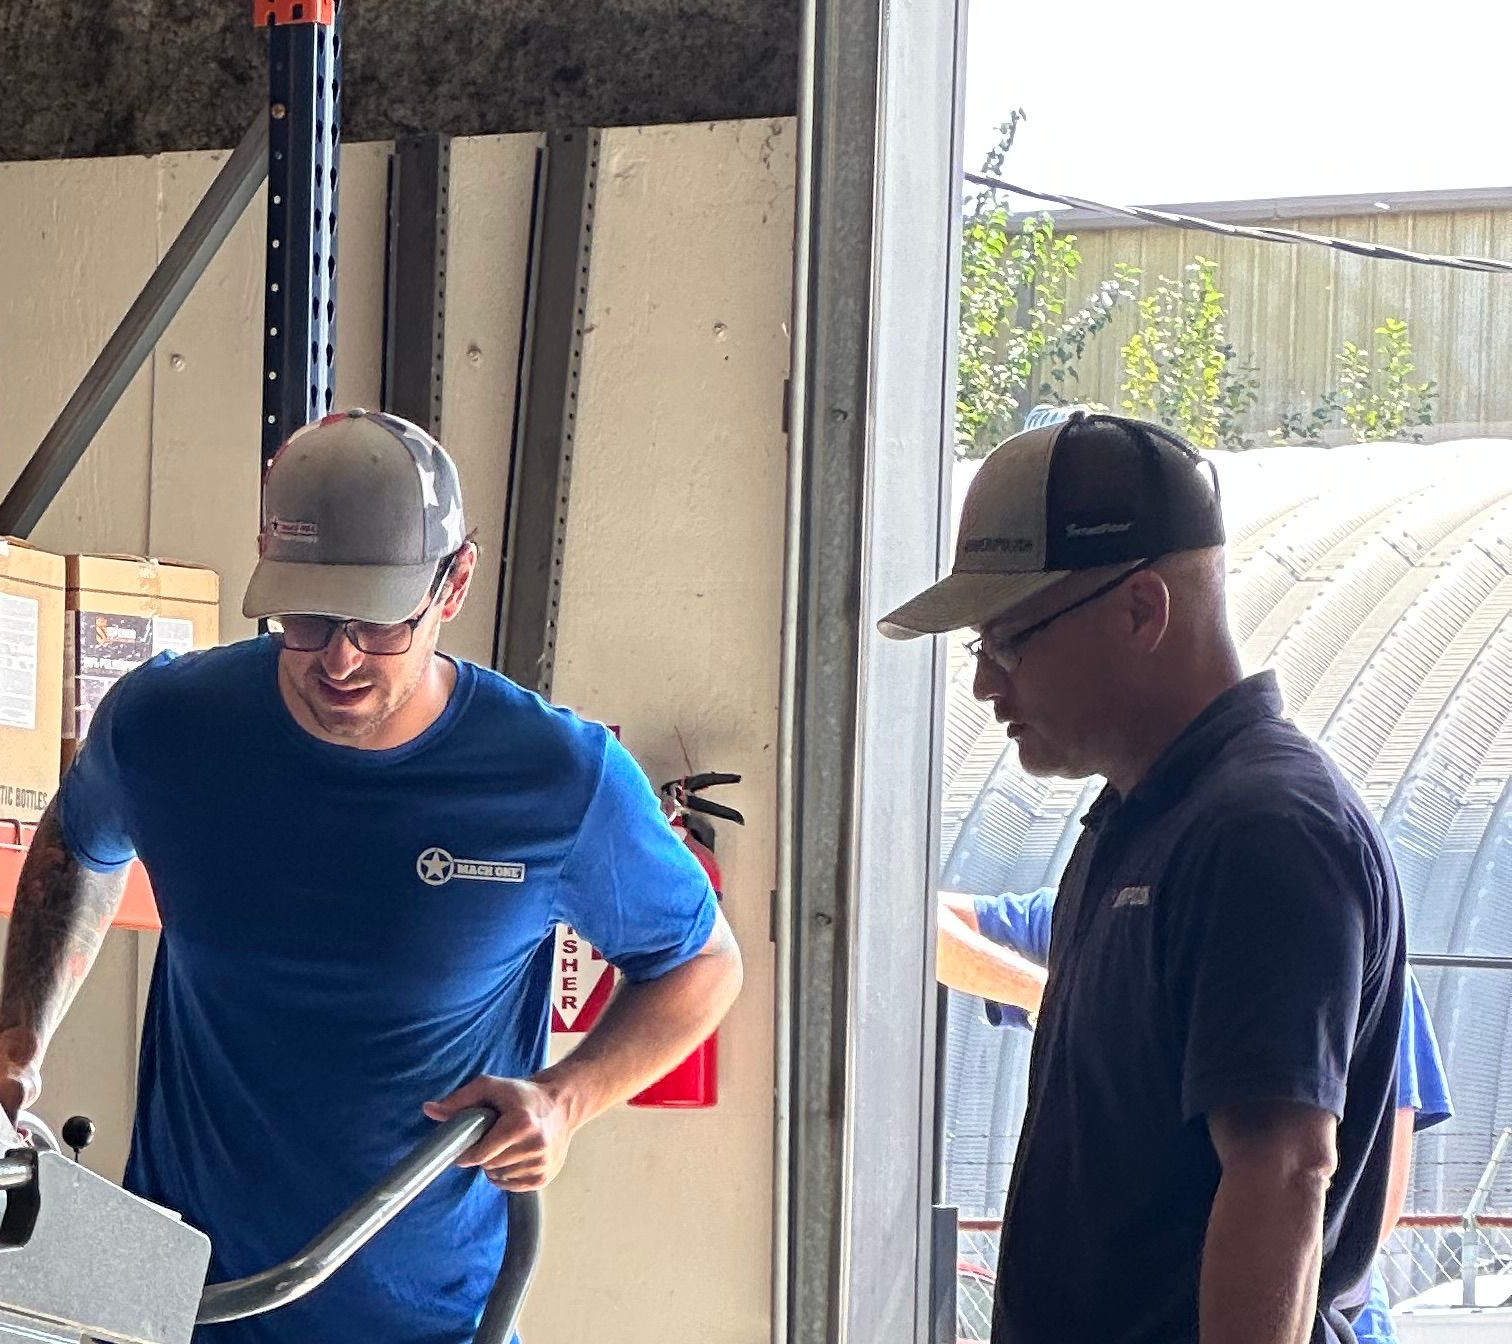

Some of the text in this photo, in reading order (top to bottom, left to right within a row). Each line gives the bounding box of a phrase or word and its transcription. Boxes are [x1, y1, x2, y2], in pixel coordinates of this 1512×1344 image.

[15, 787, 48, 811] BOTTLES
[456, 863, 522, 878] MACH ONE
